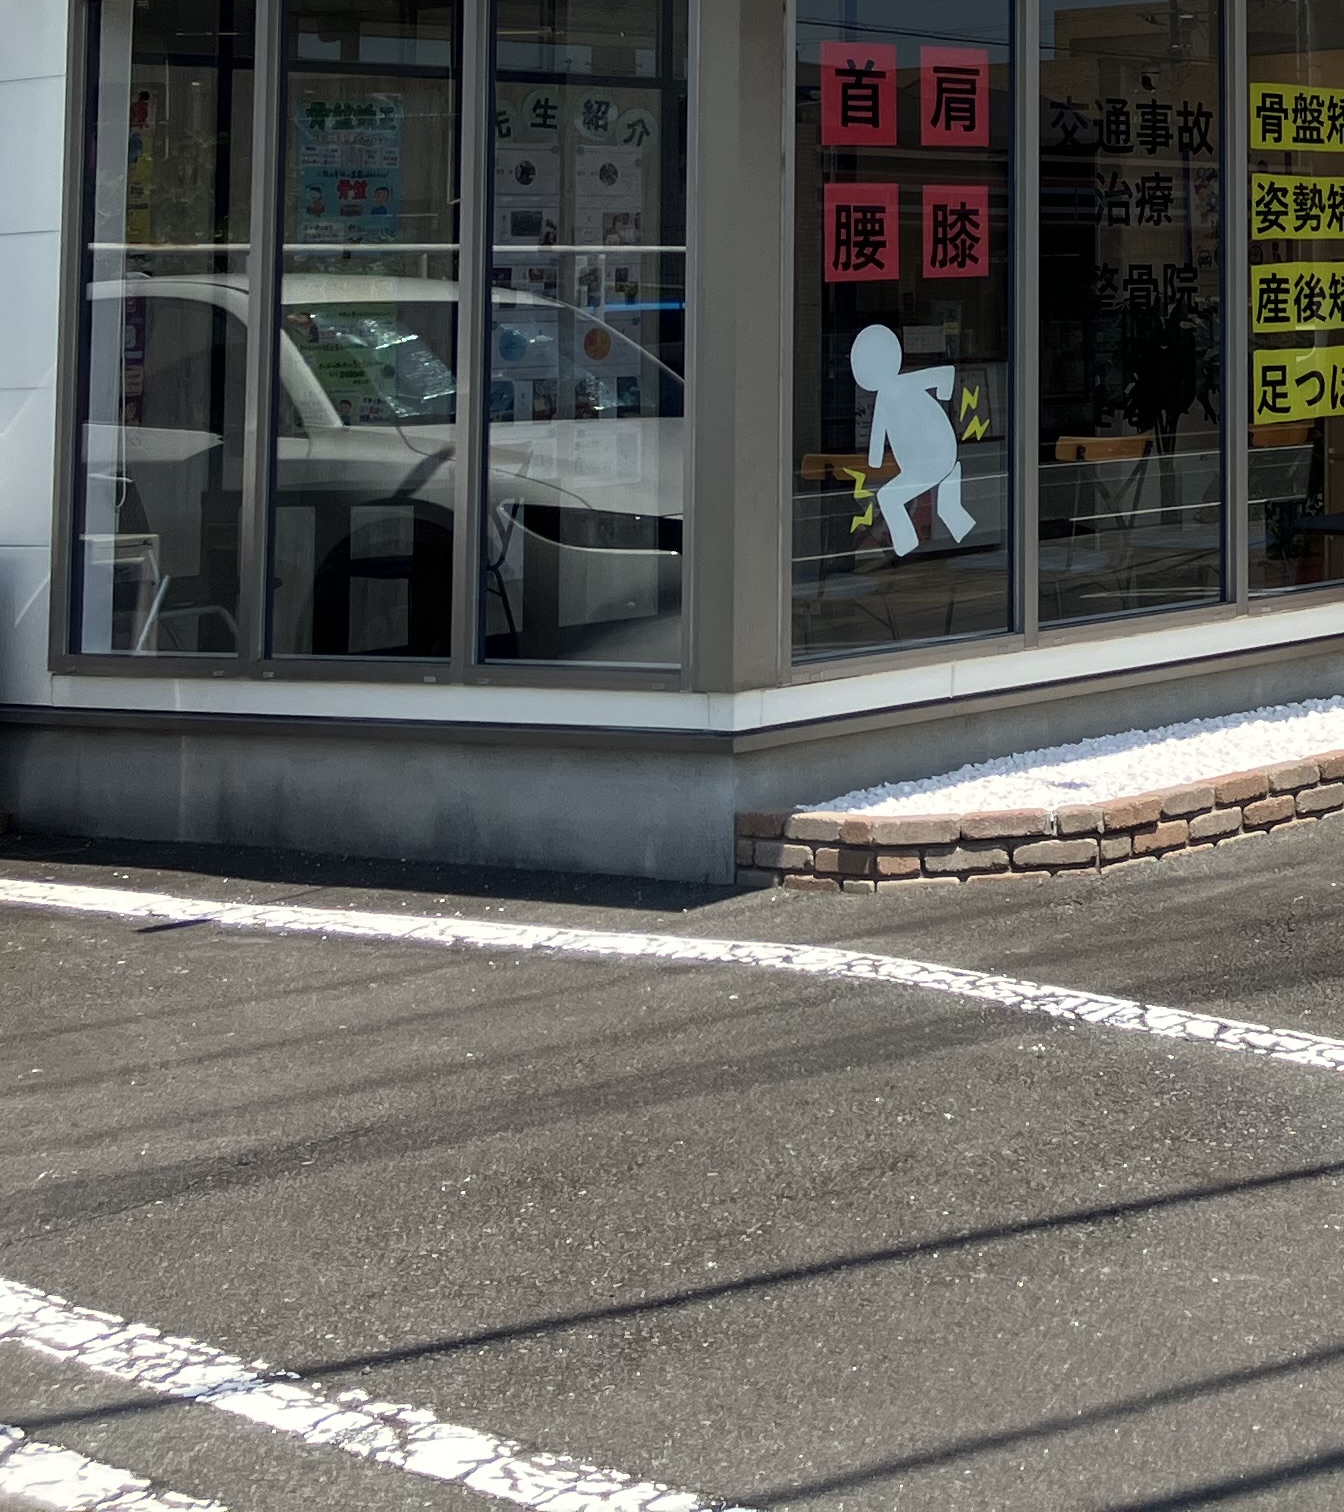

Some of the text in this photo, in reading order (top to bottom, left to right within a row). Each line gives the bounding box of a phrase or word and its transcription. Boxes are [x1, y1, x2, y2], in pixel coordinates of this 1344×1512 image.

[834, 58, 887, 128] 首
[930, 65, 980, 133] 肩
[1050, 97, 1216, 156] 交通事故
[1095, 171, 1174, 228] 治療
[832, 204, 888, 271] 腰
[930, 201, 982, 269] 膝
